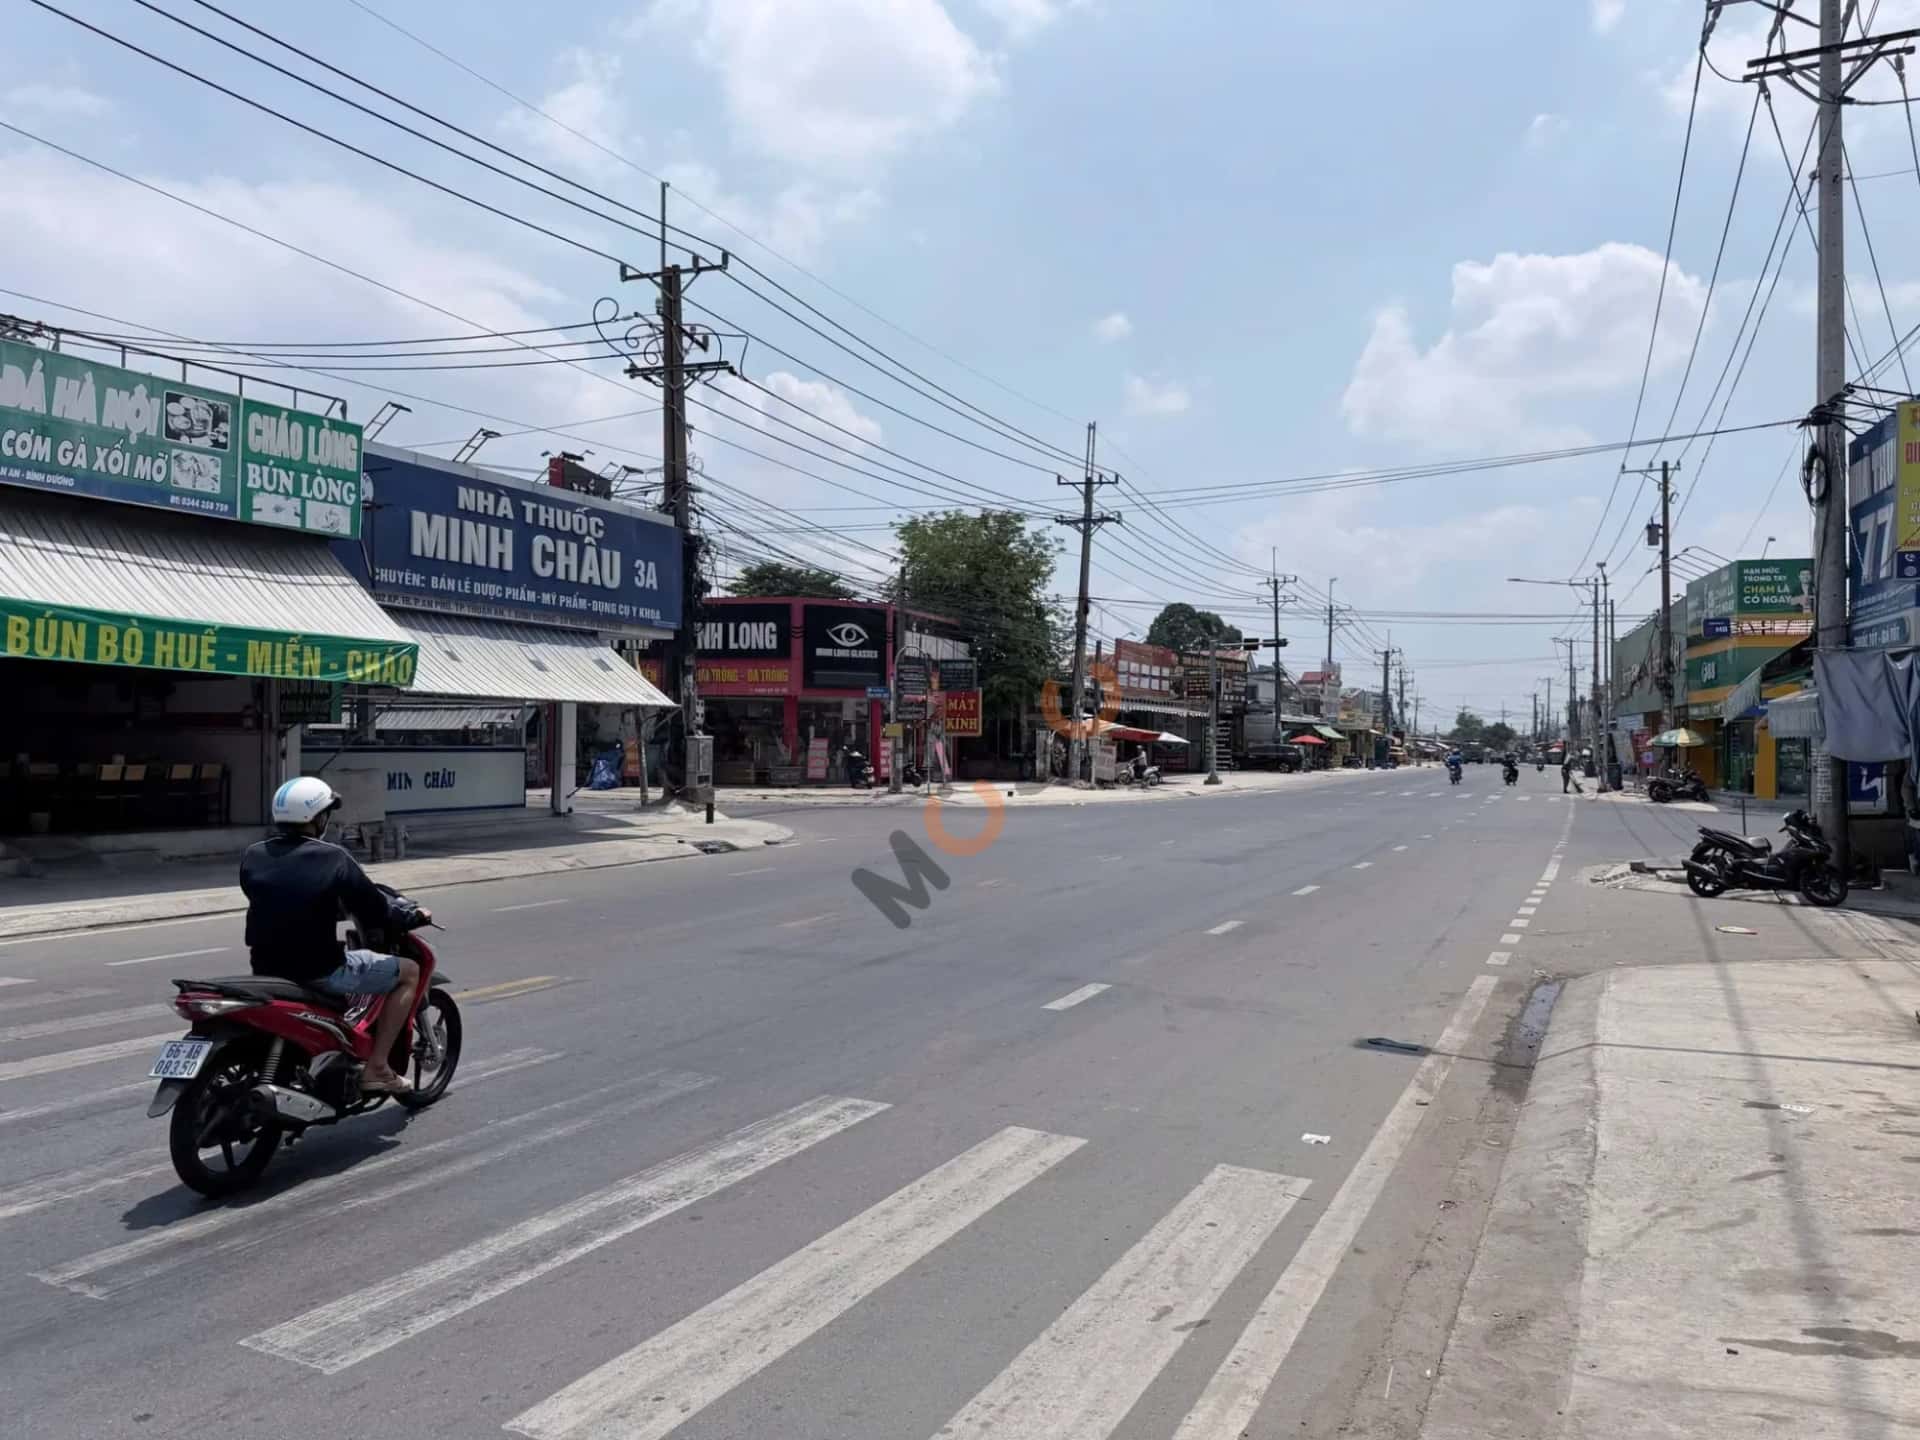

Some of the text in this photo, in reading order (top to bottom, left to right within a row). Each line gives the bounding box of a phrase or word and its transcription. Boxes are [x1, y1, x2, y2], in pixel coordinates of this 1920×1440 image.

[51, 371, 97, 425] HÀ
[102, 384, 160, 444] NỘI
[1, 429, 169, 482] CƠM GÀ XỐI MỠ
[248, 411, 357, 472] CHÁO LÒNG
[247, 461, 356, 506] BÚN LÒNG
[457, 486, 605, 539] NHÀ THUỐC
[410, 510, 658, 591] MINH CHÂU 3A
[431, 573, 456, 591] BÁN
[1743, 594, 1760, 604] CÓ
[7, 611, 412, 684] BÚN BÒ HUẾ MIẾN CHÁO
[729, 622, 777, 649] LONG
[946, 714, 977, 730] KÍNH
[424, 768, 455, 788] CHÂU
